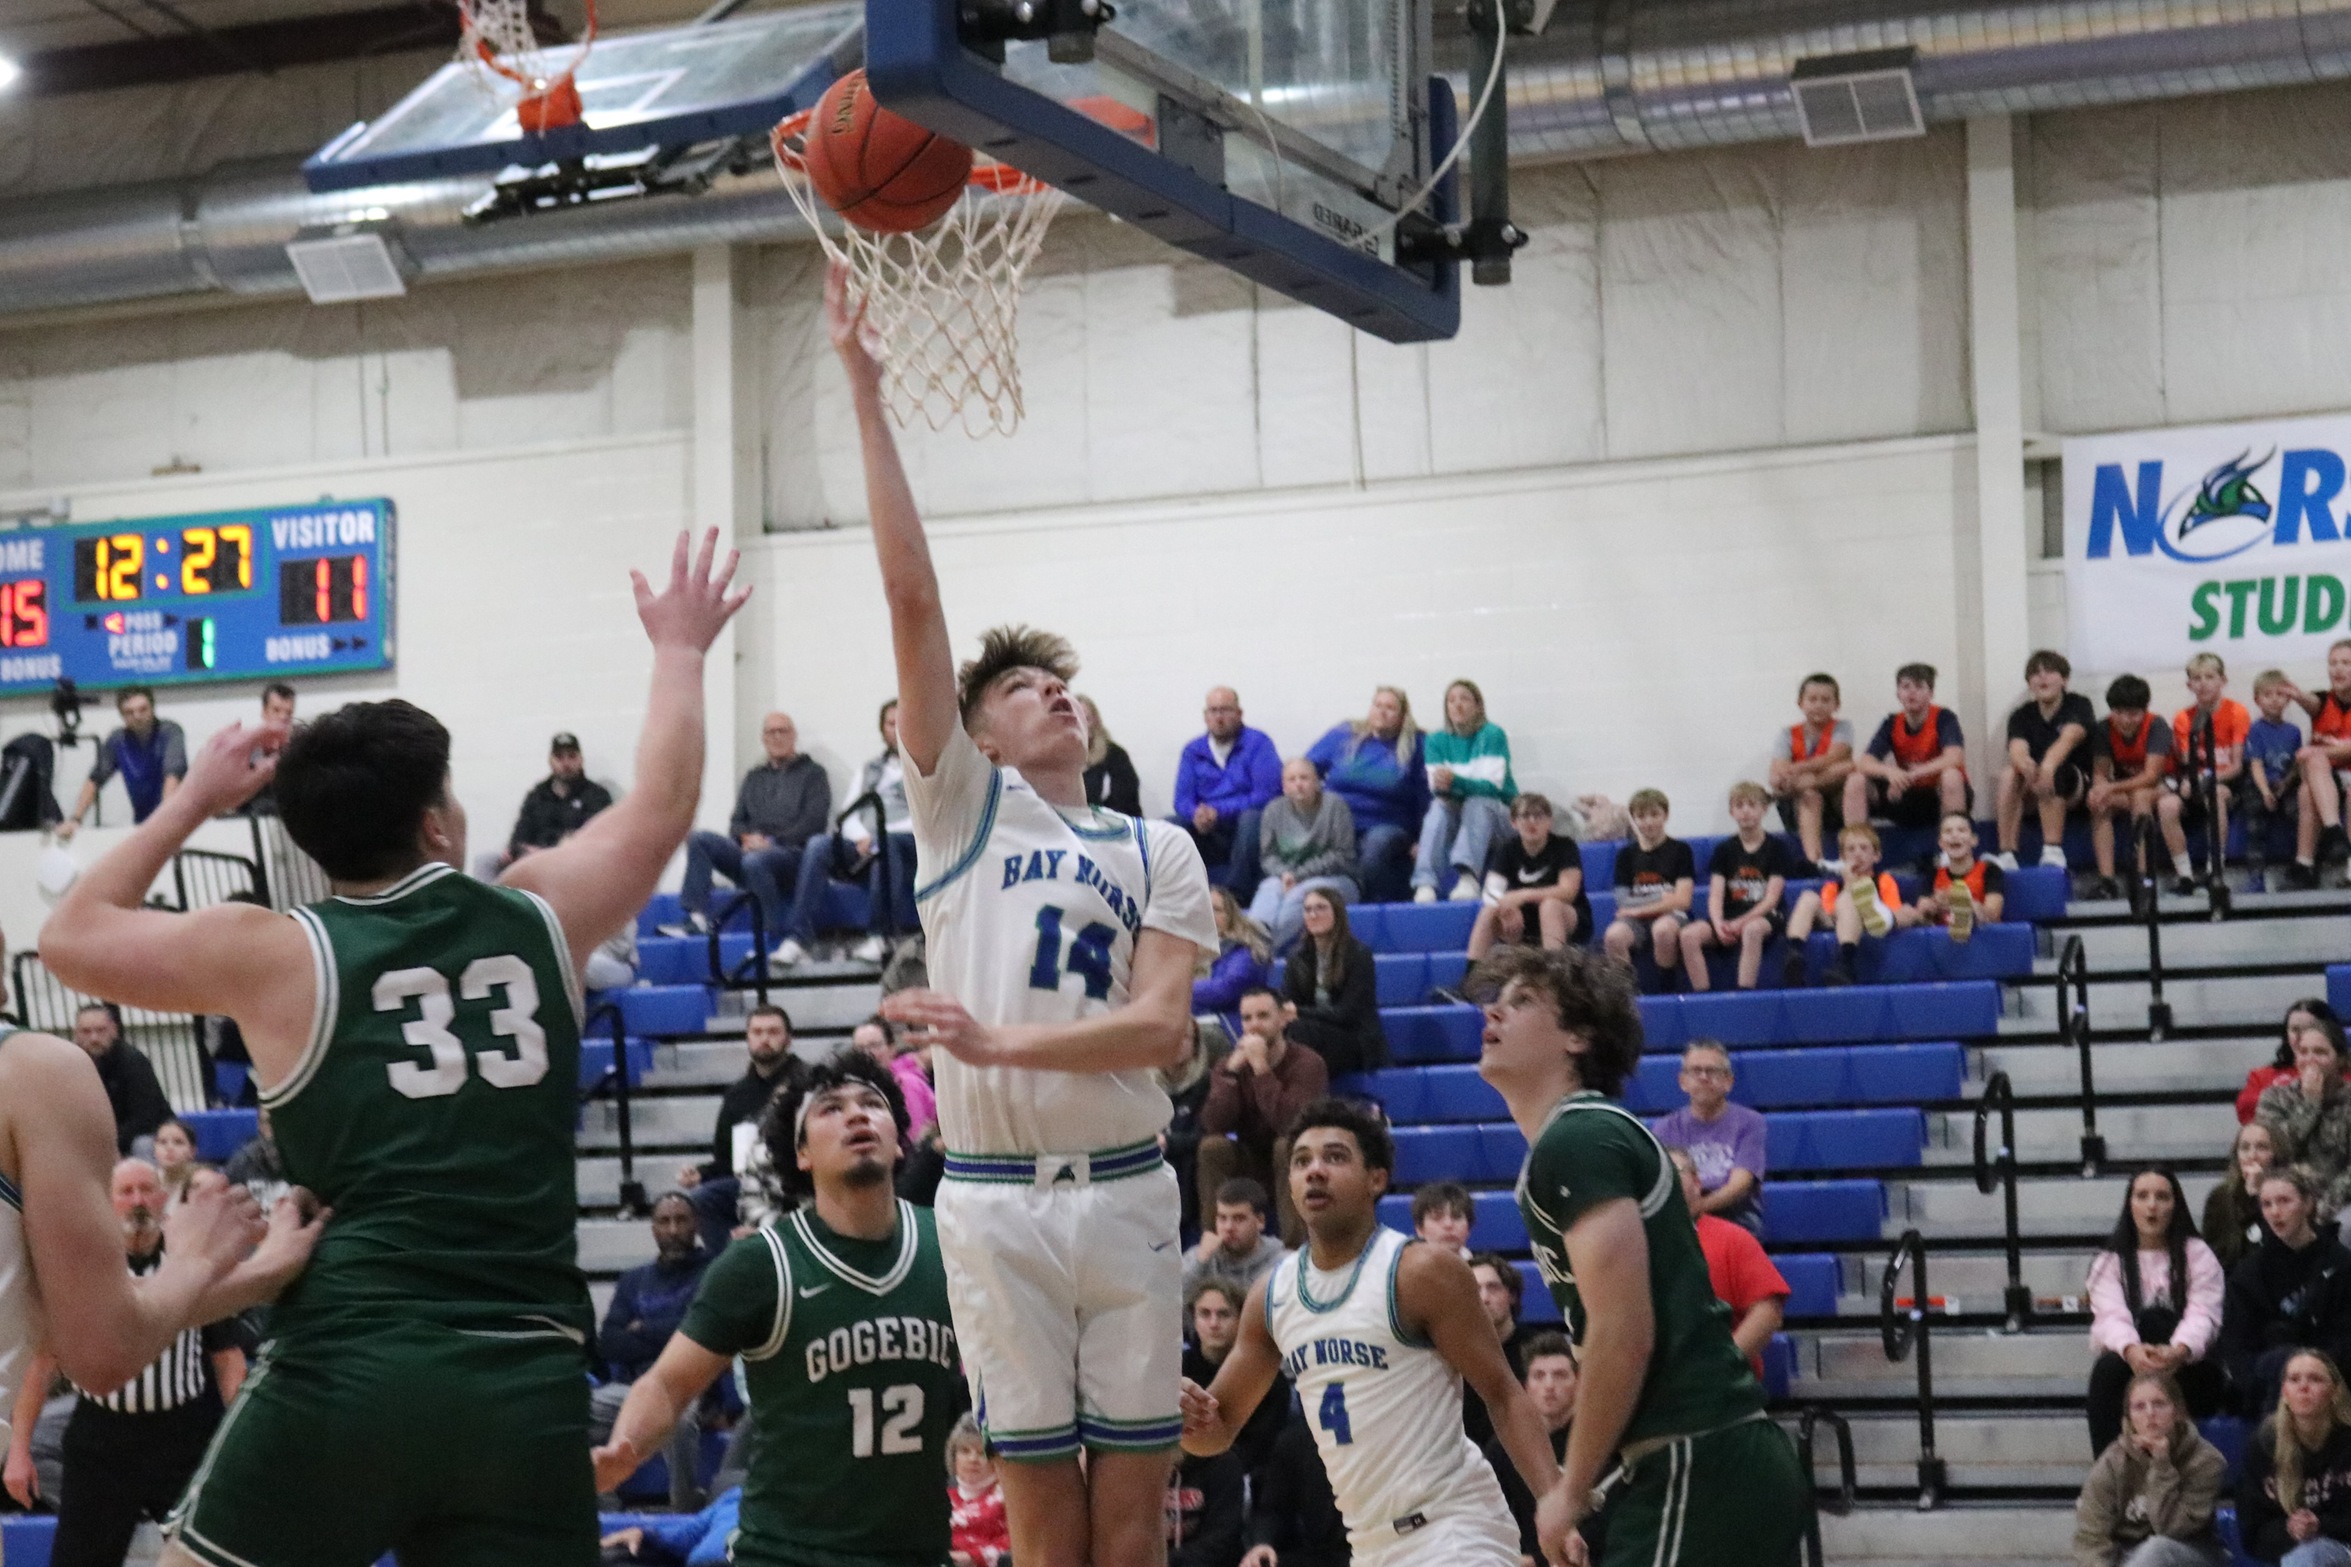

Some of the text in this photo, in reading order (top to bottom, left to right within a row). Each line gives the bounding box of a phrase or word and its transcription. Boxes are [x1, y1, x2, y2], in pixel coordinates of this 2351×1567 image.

[95, 523, 253, 600] 12:27
[271, 510, 375, 550] VISITOR
[0, 580, 48, 647] 15
[315, 554, 367, 623] 11
[108, 630, 178, 657] PERIOD
[201, 617, 215, 669] 1
[266, 635, 330, 662] BONUS
[1001, 849, 1067, 890] BAY
[1029, 904, 1117, 1000] 14
[371, 954, 549, 1099] 33
[805, 1316, 956, 1384] GOGEBIC
[1286, 1337, 1389, 1376] AY NORSE
[848, 1383, 925, 1458] 12
[1318, 1382, 1353, 1445] 4
